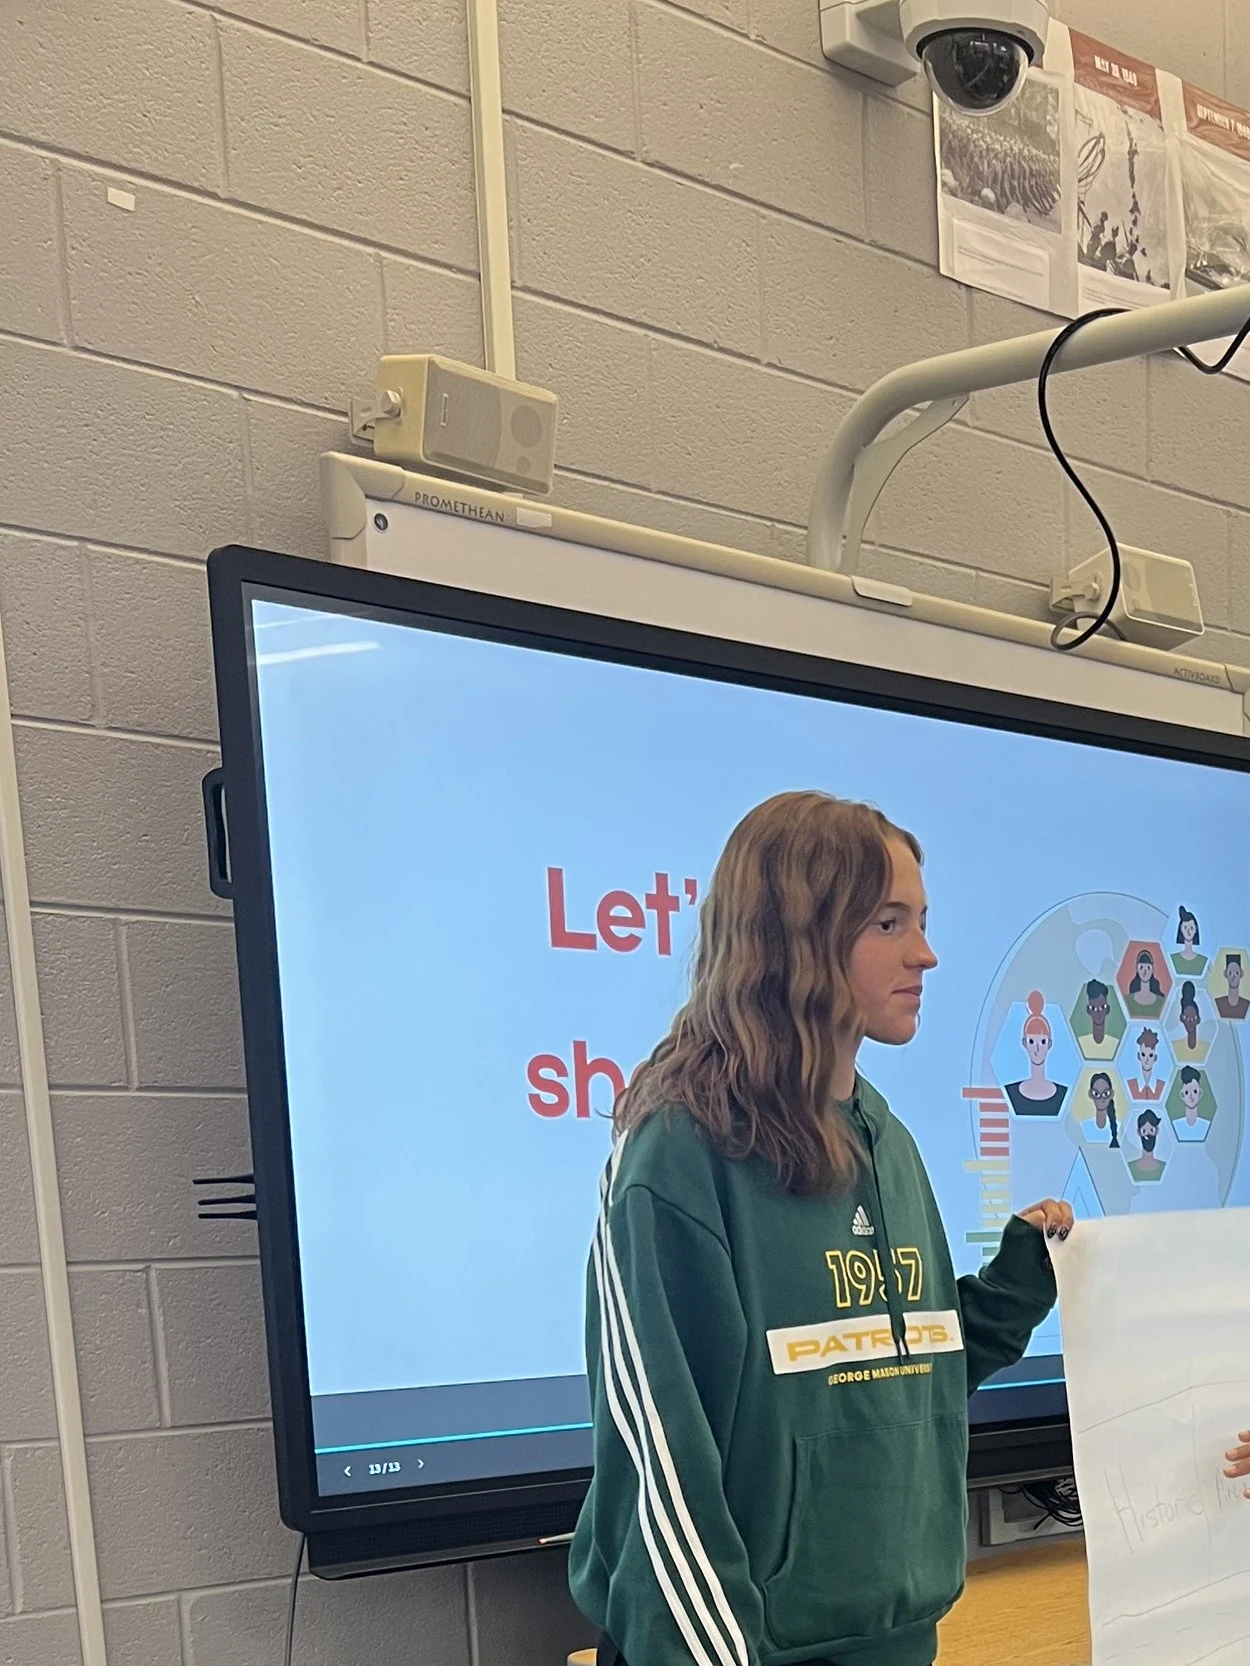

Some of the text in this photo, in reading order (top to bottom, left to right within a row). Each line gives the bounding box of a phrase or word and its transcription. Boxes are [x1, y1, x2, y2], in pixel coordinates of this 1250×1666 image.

[414, 492, 505, 521] PROMETHEAN
[546, 866, 699, 957] Let'
[526, 1039, 634, 1119] sh
[786, 1324, 948, 1363] PATROTS
[828, 1369, 871, 1386] GEORGE
[871, 1365, 899, 1380] MASON
